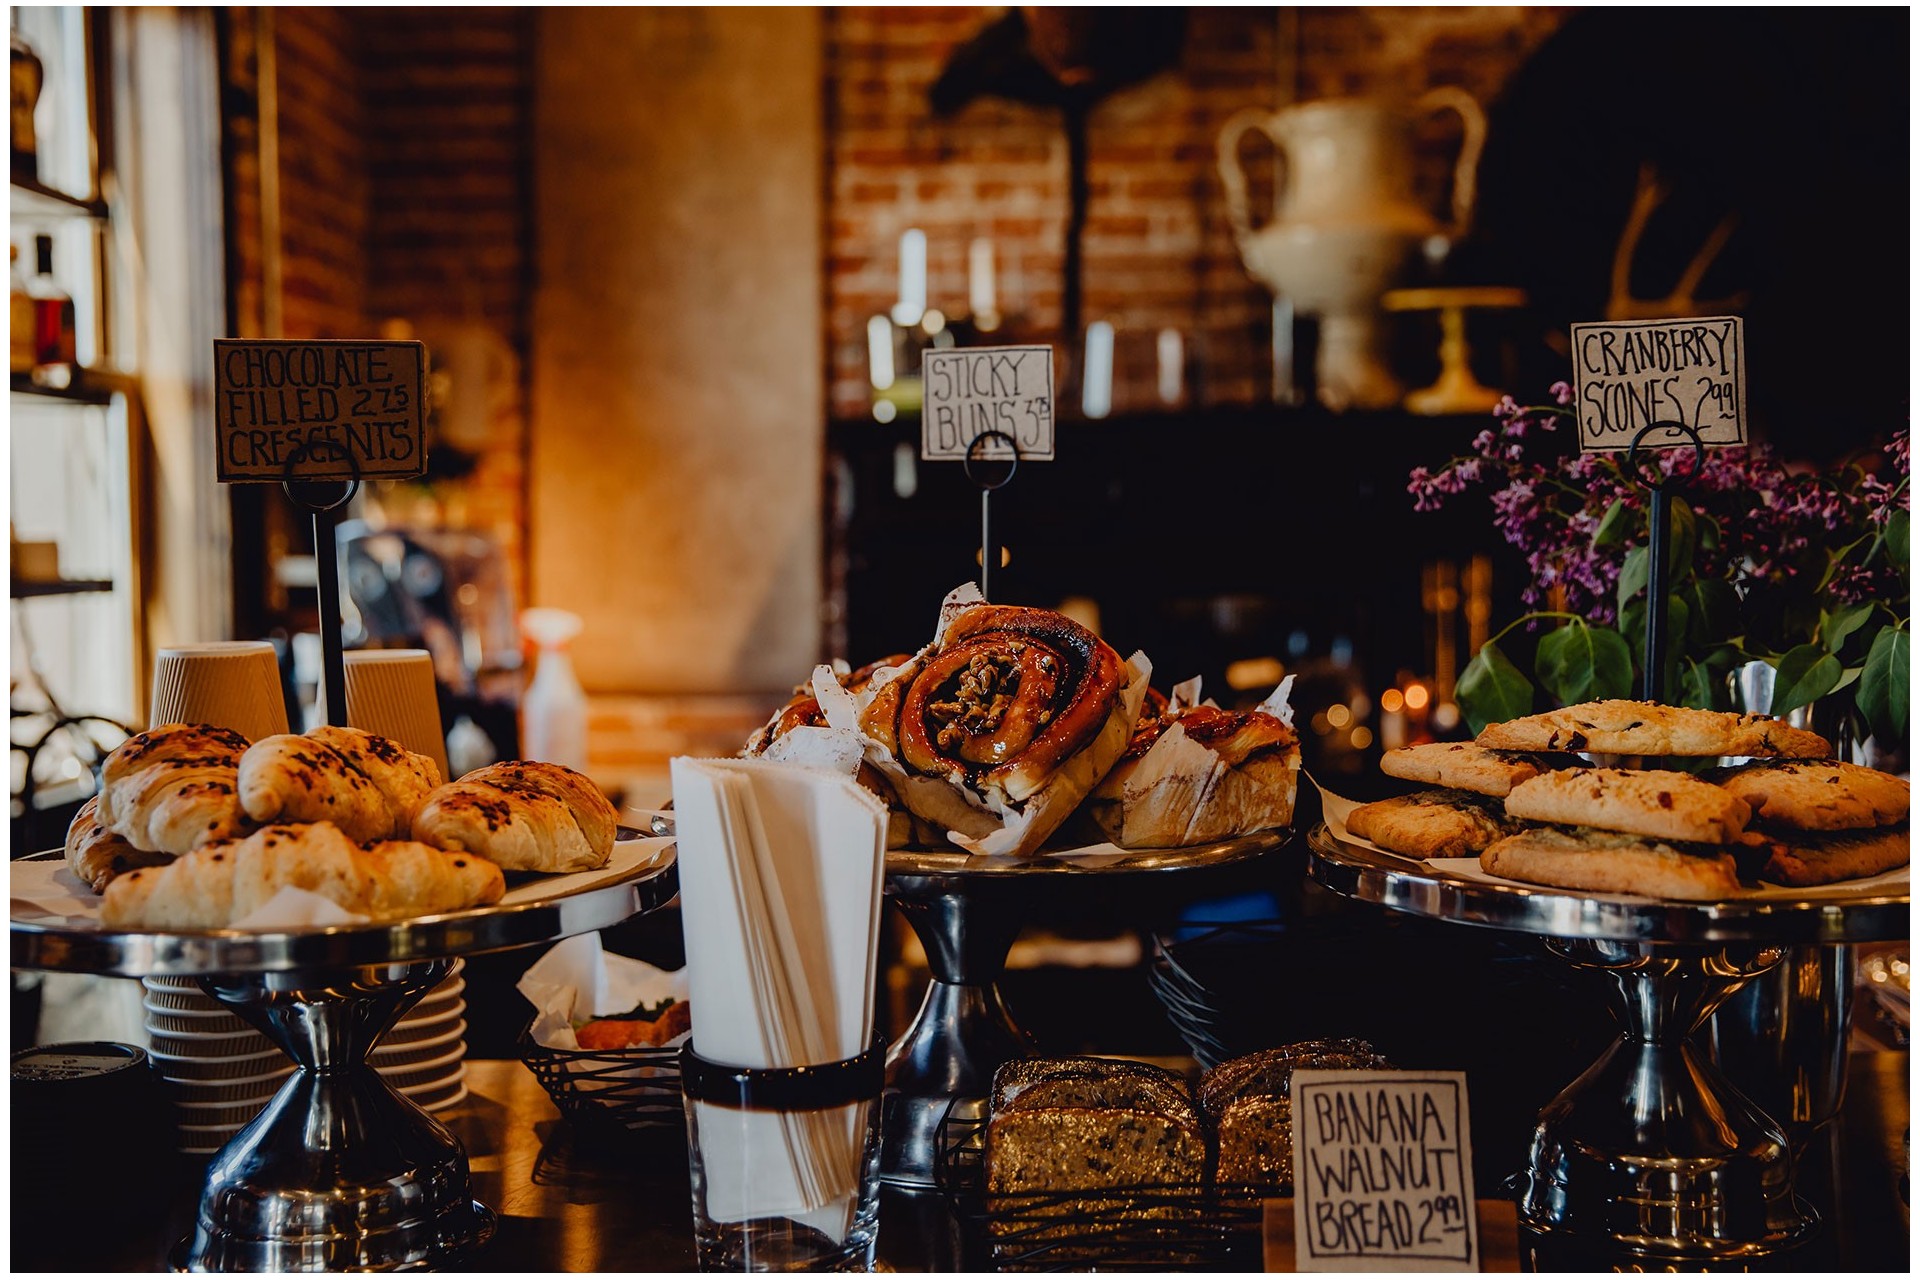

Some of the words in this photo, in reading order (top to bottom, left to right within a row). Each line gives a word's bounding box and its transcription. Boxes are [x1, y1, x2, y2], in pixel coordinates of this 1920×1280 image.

[226, 347, 394, 389] CHOCOLATE
[1583, 322, 1732, 377] CRANBERRY
[932, 352, 1027, 402] STICKY
[225, 387, 339, 428] FILLED
[936, 400, 1017, 450] BUNS
[1584, 376, 1686, 438] SCONES
[228, 419, 414, 467] CRESCENTS
[1313, 1088, 1447, 1147] BANANA
[1310, 1142, 1456, 1198] WALNUT
[1316, 1199, 1414, 1254] BREAD
